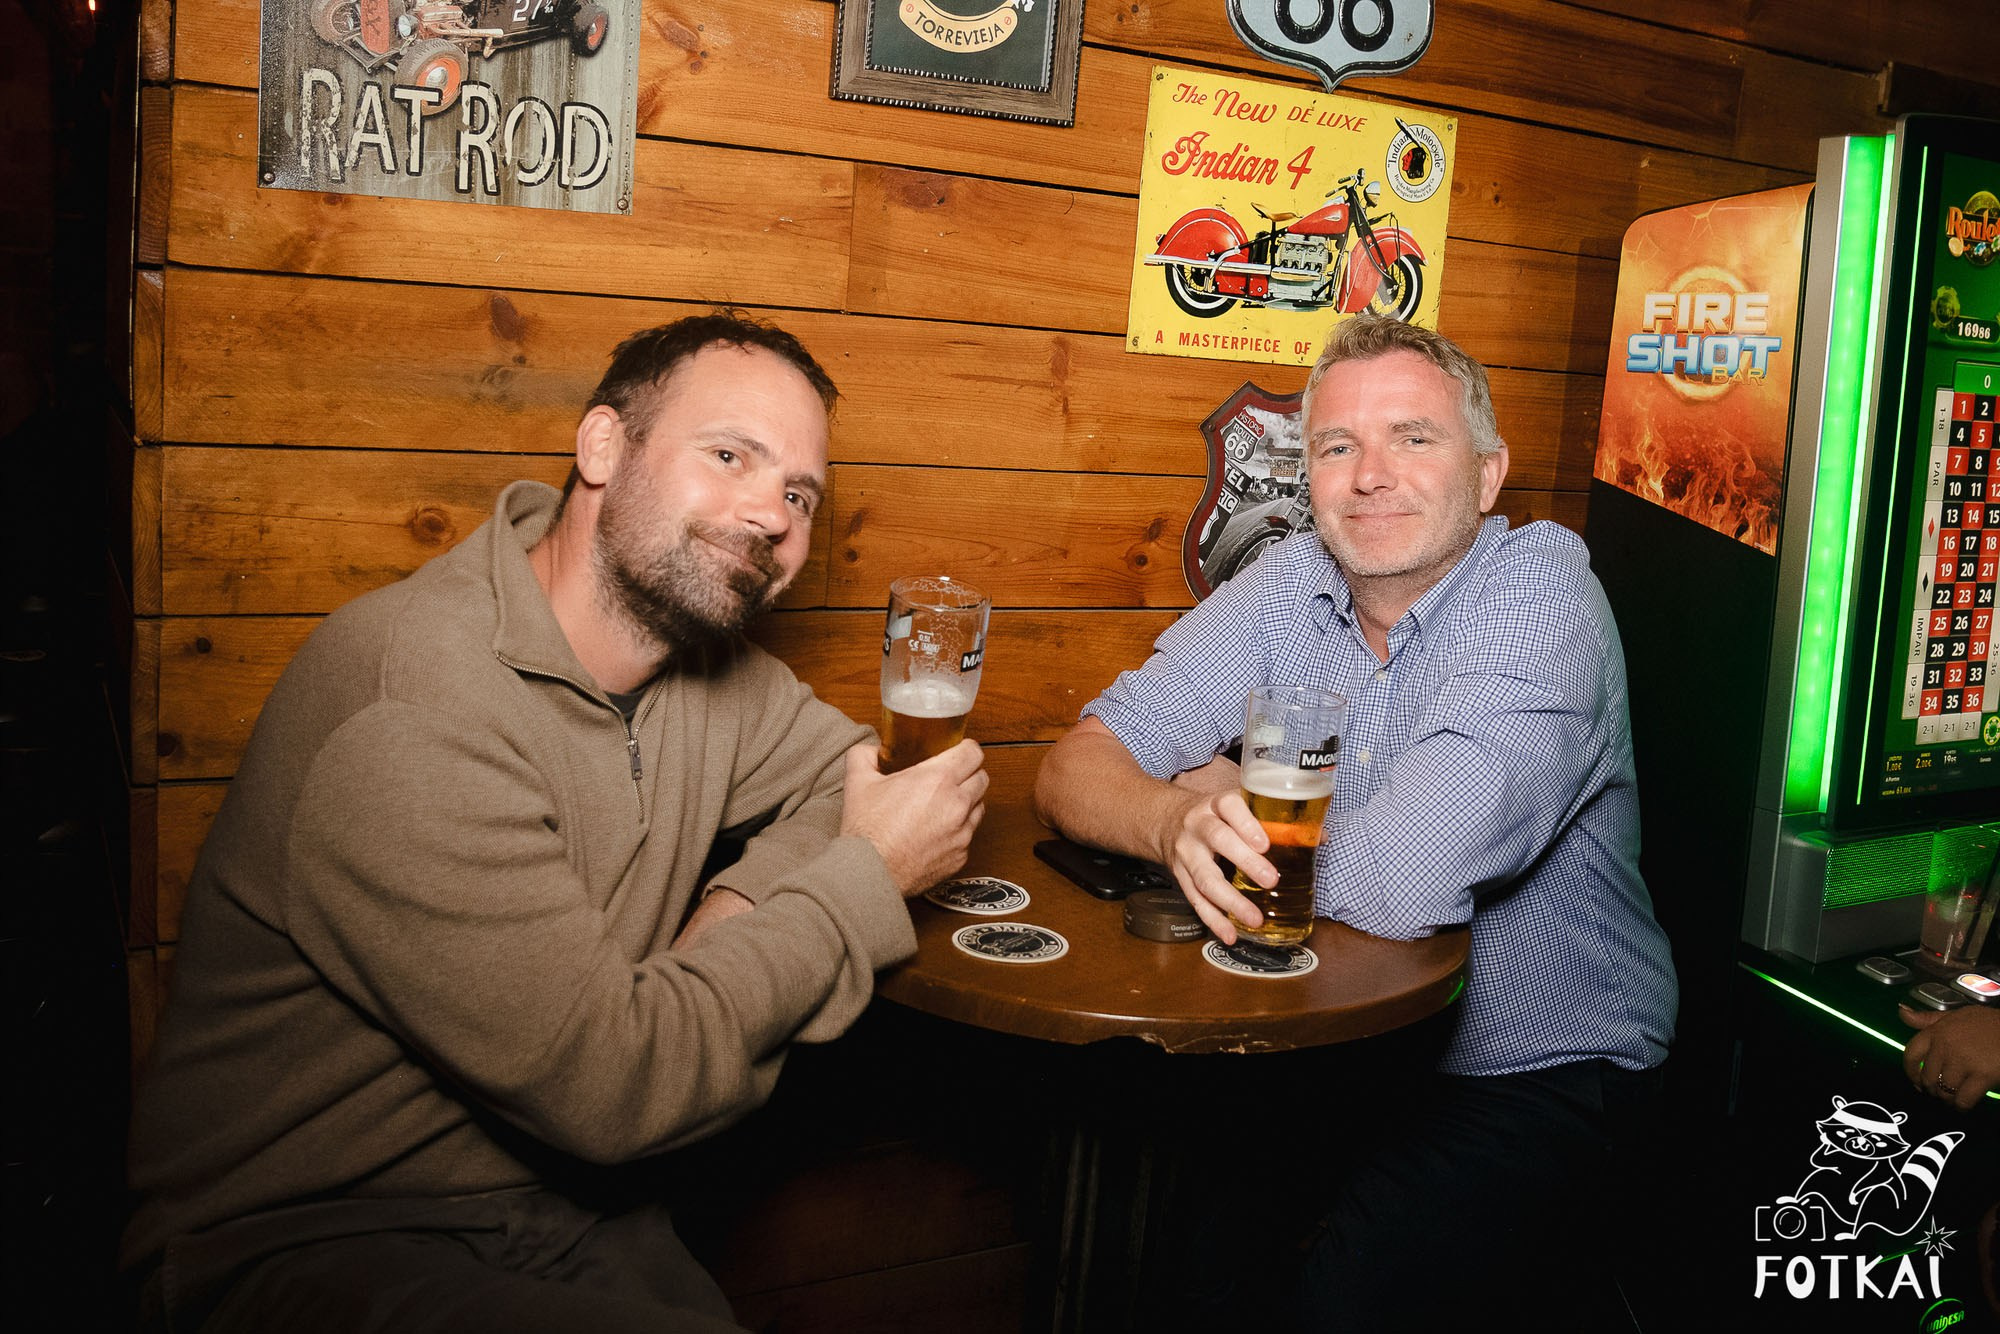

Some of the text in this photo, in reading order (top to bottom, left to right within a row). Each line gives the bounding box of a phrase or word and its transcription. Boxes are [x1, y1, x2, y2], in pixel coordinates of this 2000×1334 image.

[914, 12, 1004, 46] TORREVIEJA
[1172, 82, 1208, 106] The
[1213, 88, 1279, 124] New
[1316, 111, 1369, 133] LUXE
[299, 68, 613, 195] RAT ROD
[1161, 131, 1316, 190] Indian 4
[1642, 291, 1770, 335] FIRE
[1155, 330, 1312, 355] A MASTERPIECE OF
[1626, 333, 1782, 379] SHOT
[1711, 366, 1766, 386] BAR
[1983, 374, 1991, 389] 0
[1961, 400, 1989, 416] 1 2
[1238, 411, 1263, 436] HISTORIC
[1233, 423, 1255, 445] ROUTE
[1956, 427, 1964, 442] 4
[1977, 428, 1986, 443] 5
[1225, 432, 1249, 460] 66
[1954, 454, 1962, 469] 7
[1975, 455, 1983, 470] 8
[1932, 461, 1941, 486] PAR
[1949, 481, 1961, 497] 10
[1971, 482, 1982, 497] 11
[1946, 508, 2000, 524] 13 14 15
[1943, 535, 1997, 551] 16 17 18
[1940, 562, 1994, 577] 19 20 21
[1936, 588, 1991, 604] 22 23 24
[1933, 615, 1989, 631] 25 26 27
[1914, 617, 1924, 657] IMPAR
[1930, 641, 1986, 658] 28 29 30
[1927, 667, 1983, 684] 31 32 33
[1908, 674, 1917, 707] 19-36
[1924, 693, 1980, 711] 34 35 36
[1922, 725, 1935, 735] 2-1
[1943, 723, 1956, 733] 2-1
[1964, 721, 1976, 731] 2-1
